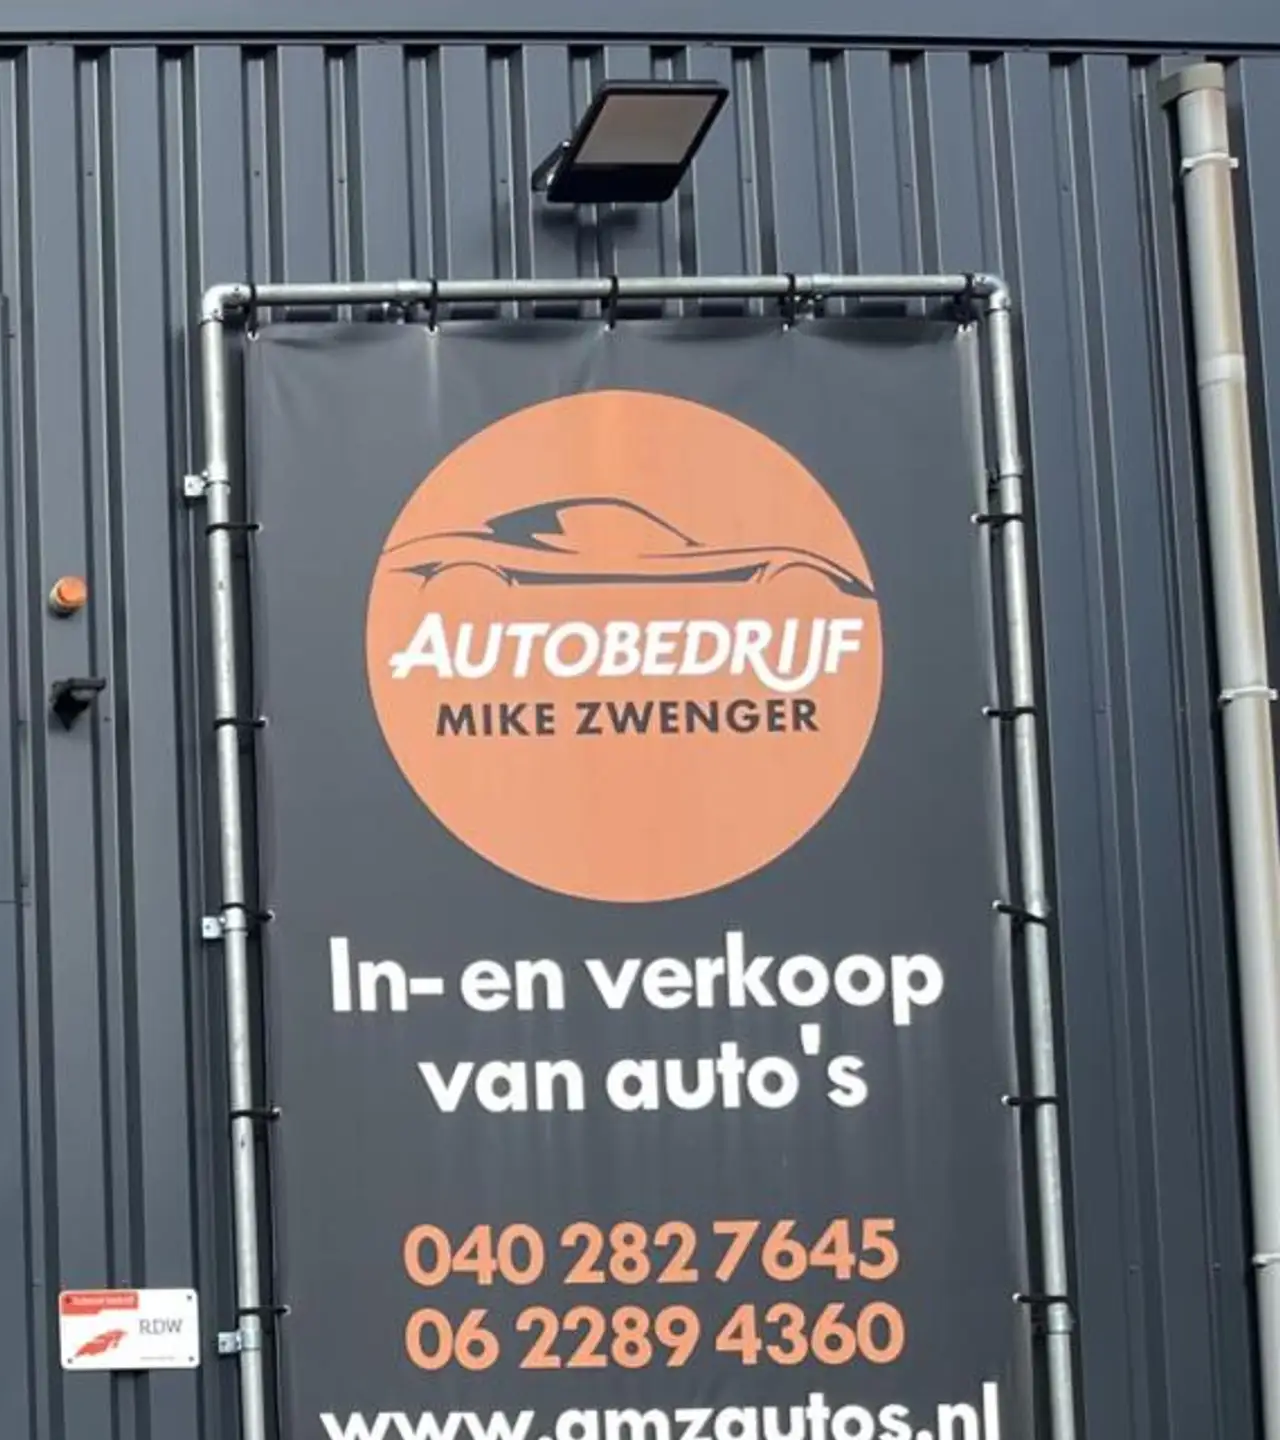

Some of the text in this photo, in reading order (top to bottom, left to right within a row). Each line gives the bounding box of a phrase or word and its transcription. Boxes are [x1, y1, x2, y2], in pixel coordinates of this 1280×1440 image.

[388, 611, 865, 694] AUTOBEDRIJF
[435, 697, 820, 737] MIKE ZWENGER
[329, 930, 946, 1028] In- en verkoop
[417, 1024, 870, 1114] van auto's
[404, 1217, 899, 1286] 040 282 7645
[138, 1318, 183, 1335] RDW
[406, 1301, 905, 1371] 06 2289 4360
